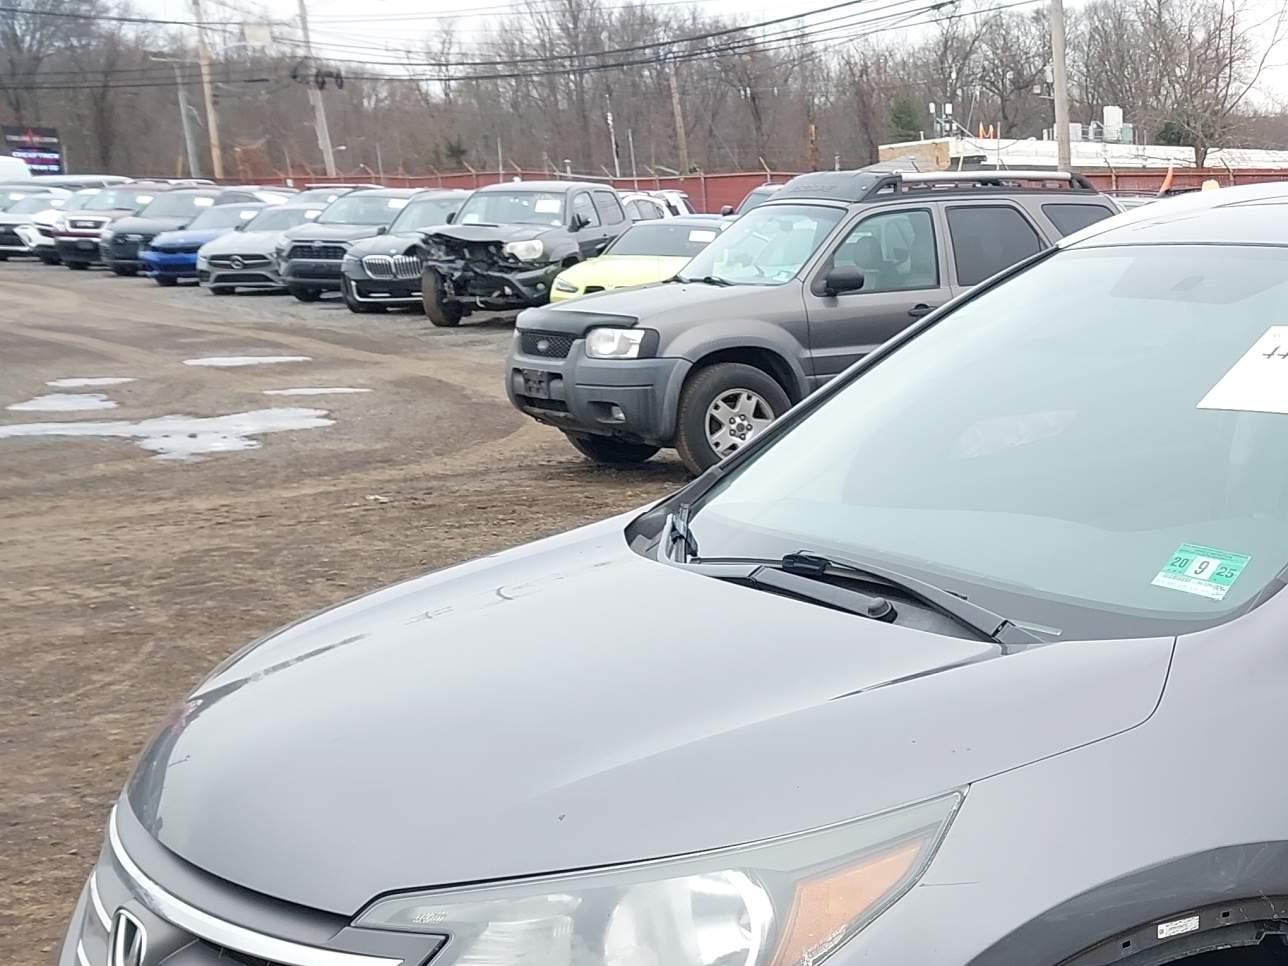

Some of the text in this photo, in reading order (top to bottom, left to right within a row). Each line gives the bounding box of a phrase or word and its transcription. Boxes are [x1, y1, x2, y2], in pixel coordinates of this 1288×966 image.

[1170, 556, 1237, 579] 20 9 25
